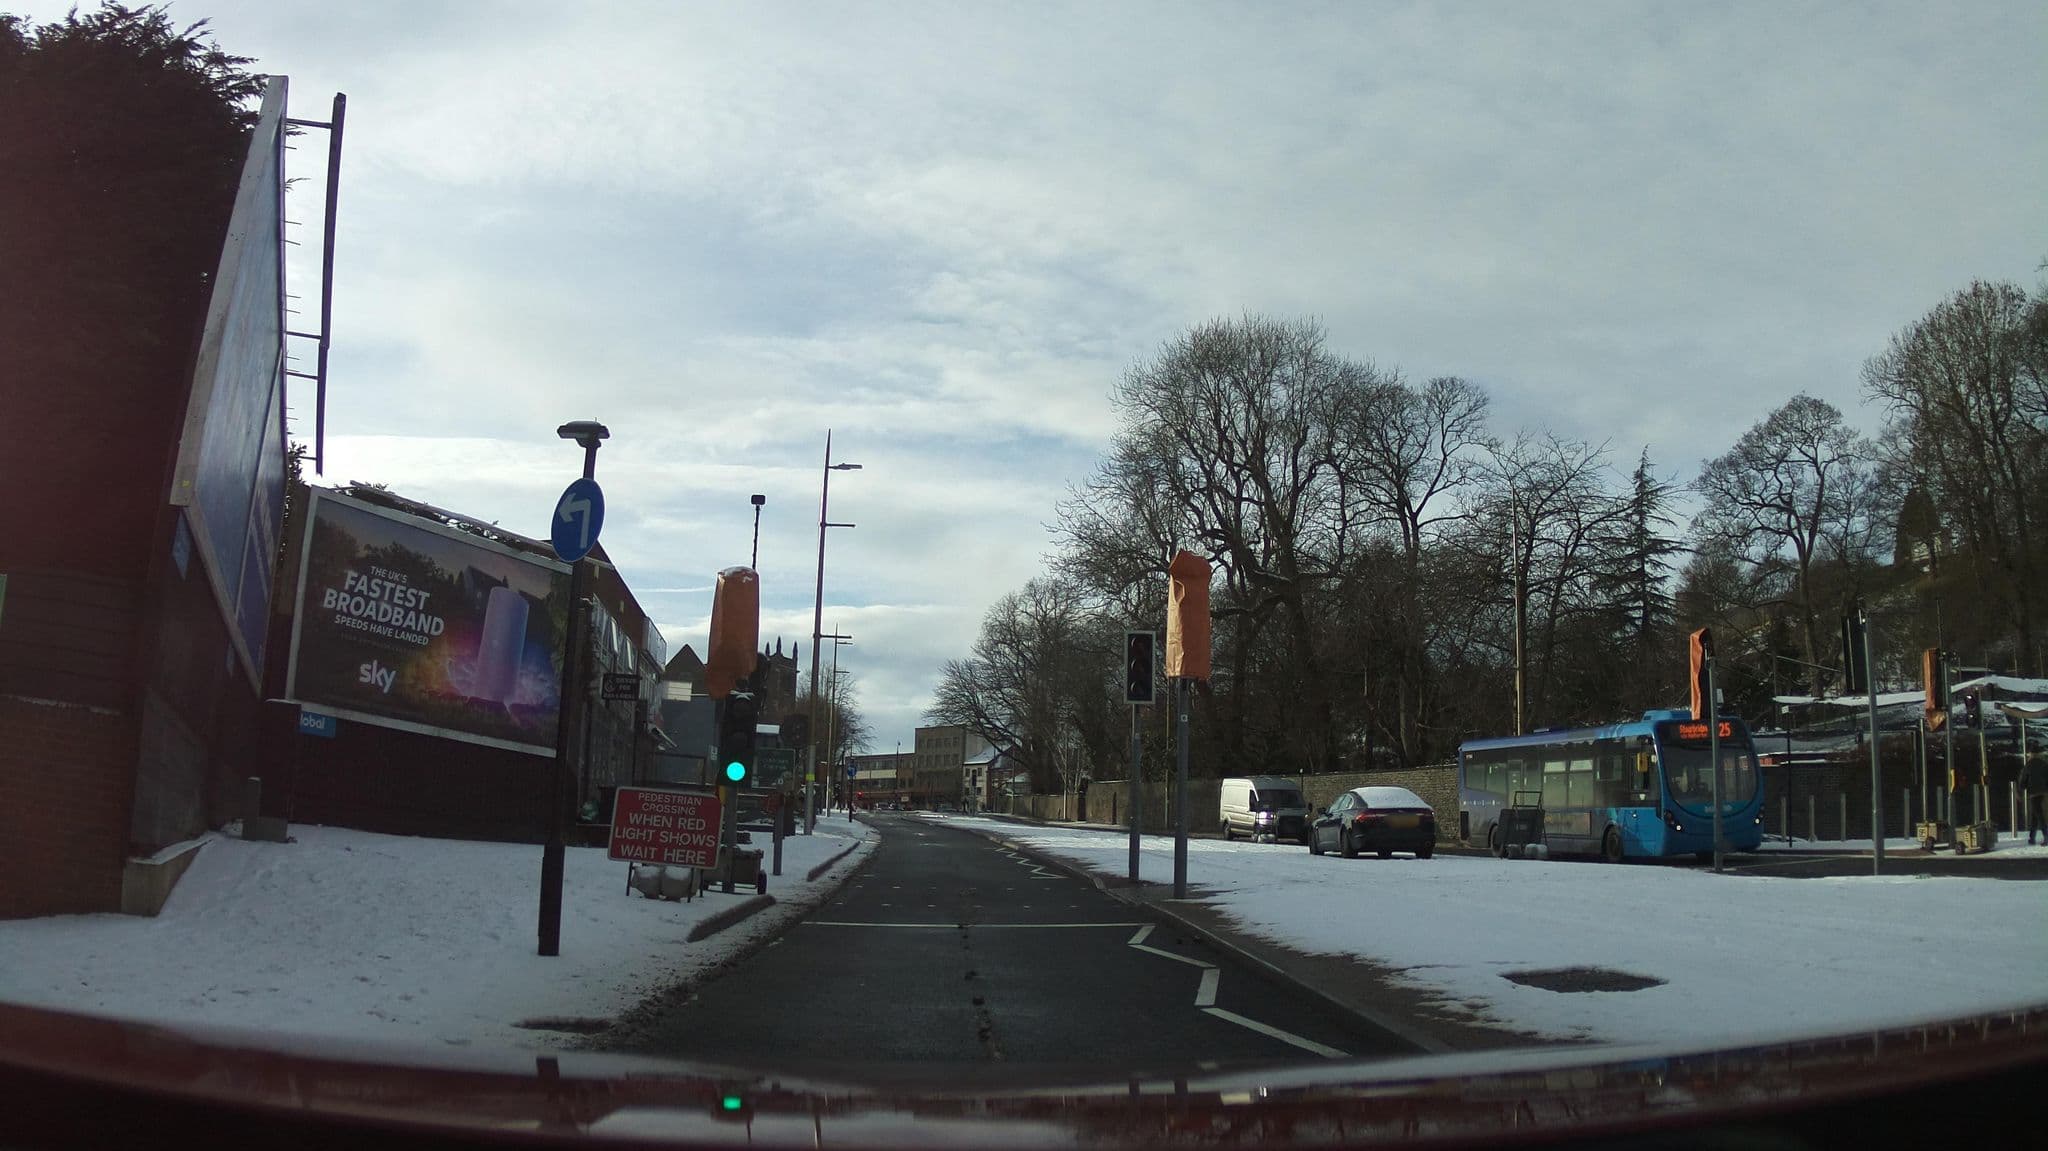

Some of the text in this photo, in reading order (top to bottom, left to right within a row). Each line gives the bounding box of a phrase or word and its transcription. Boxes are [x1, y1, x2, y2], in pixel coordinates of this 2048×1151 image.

[370, 566, 408, 584] THE UK'S
[344, 571, 430, 610] FASTEST
[323, 588, 445, 636] BROADBAND
[334, 614, 369, 632] SPEEDS
[370, 622, 393, 638] HAVE
[394, 629, 430, 646] LANDED
[359, 659, 397, 694] sky
[1718, 722, 1731, 737] 25
[638, 792, 702, 806] PEDESTRIAN
[641, 802, 696, 816] CROSSING
[629, 812, 706, 831] WHEN RED
[615, 826, 716, 848] LIGHT SHOWS
[620, 845, 707, 864] WAIT HERE
